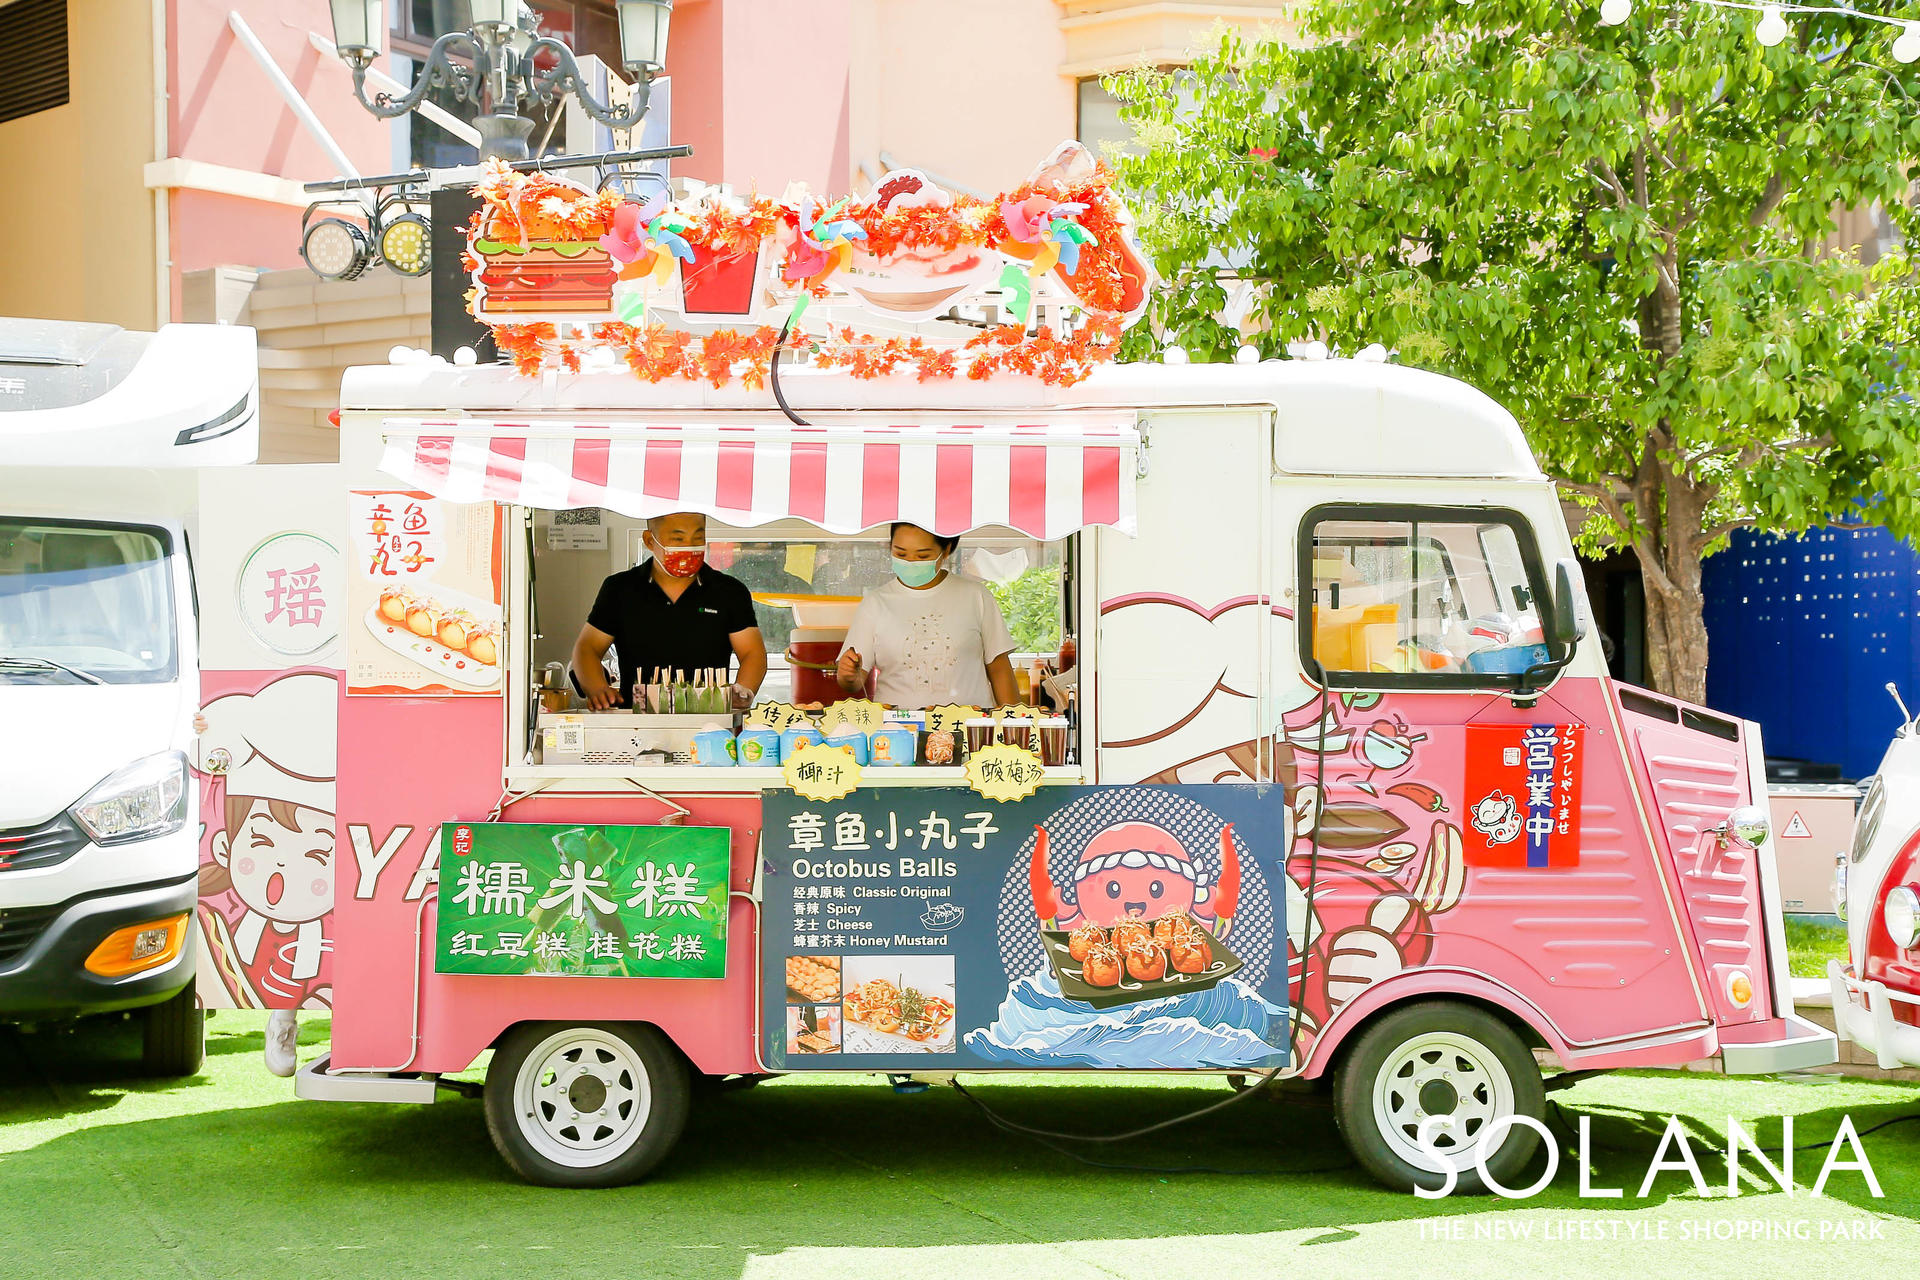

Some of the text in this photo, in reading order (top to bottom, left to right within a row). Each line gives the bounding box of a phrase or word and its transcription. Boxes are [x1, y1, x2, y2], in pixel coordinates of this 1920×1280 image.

[366, 502, 431, 543] 章鱼
[264, 562, 327, 628] 瑶
[931, 713, 963, 731] 芝士
[796, 761, 844, 785] 椰汁
[981, 757, 1042, 786] 酸梅汤
[1521, 727, 1560, 848] 営業中
[792, 857, 958, 879] Octobus Balls
[451, 860, 710, 919] 糯米糕
[793, 885, 951, 900] 经典原味 Classic Original
[793, 902, 862, 917] 香辣 Spicy
[793, 918, 873, 932] 芝士 Cheese
[450, 930, 708, 961] 红豆糕 桂花糕
[793, 934, 948, 949] 蜂蜜芥末 Honey Mustard
